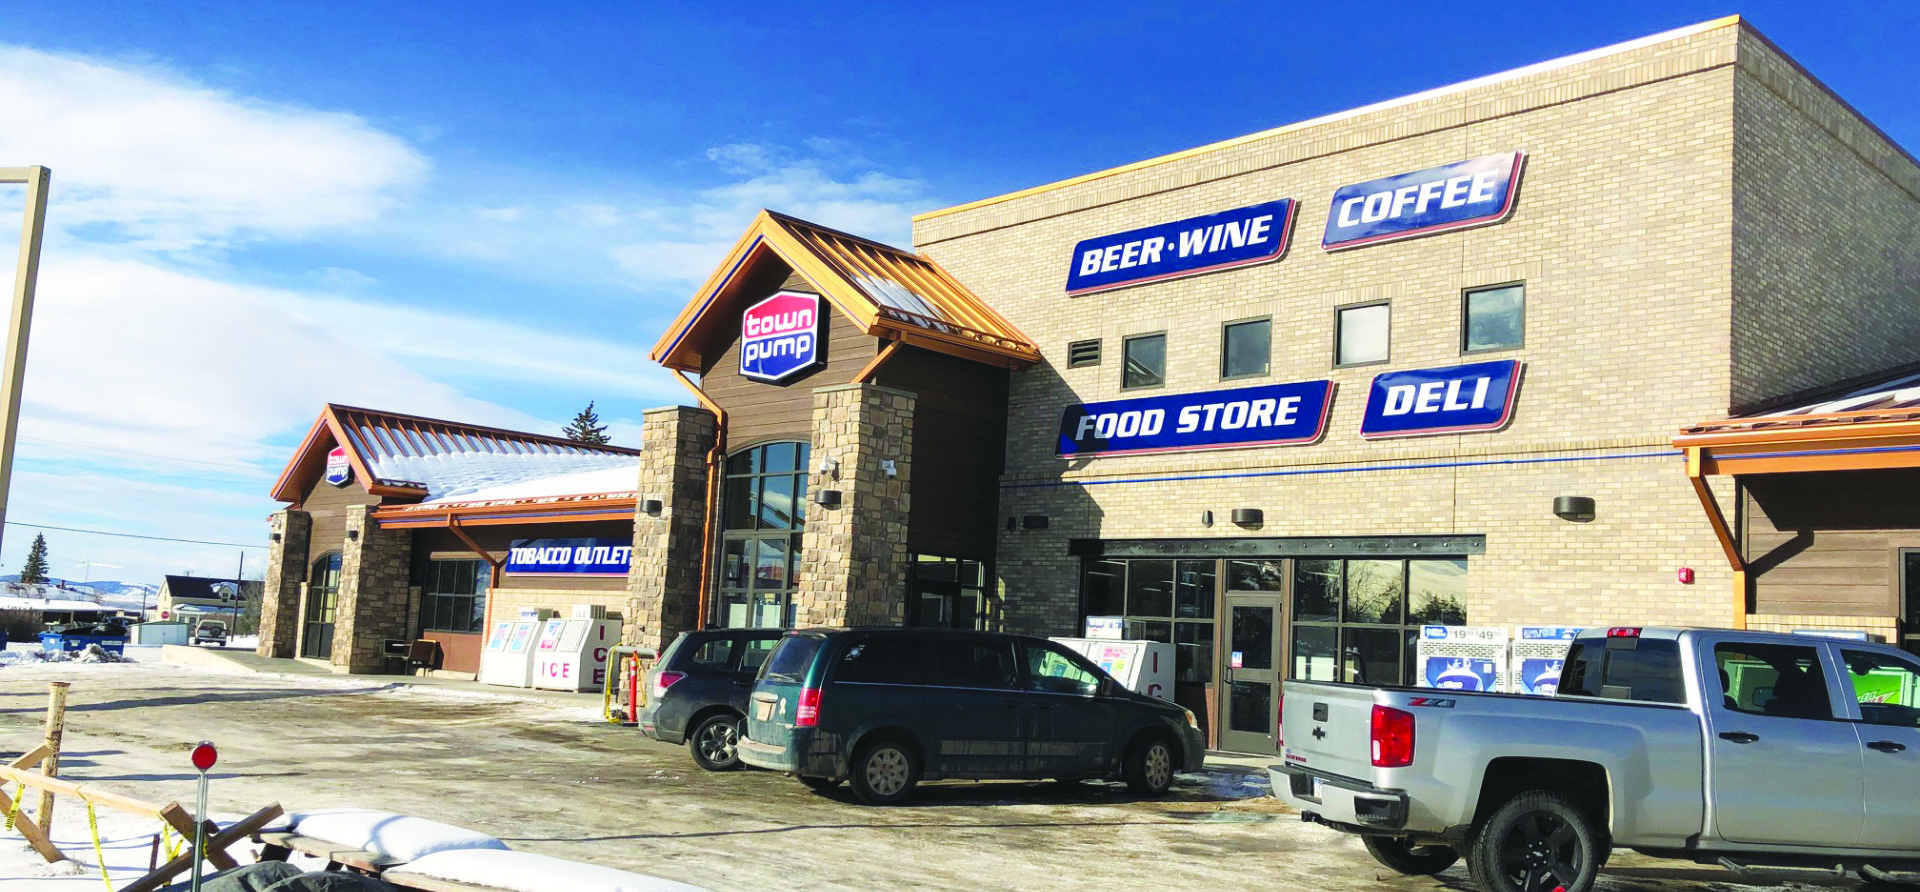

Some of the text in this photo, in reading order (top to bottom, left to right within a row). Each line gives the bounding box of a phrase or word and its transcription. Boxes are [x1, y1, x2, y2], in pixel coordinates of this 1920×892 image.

[1337, 169, 1499, 229] COFFEE
[746, 309, 812, 336] town
[745, 334, 811, 367] pump
[1382, 377, 1491, 416] DELI
[1075, 395, 1302, 441] FOOD STORE
[510, 546, 632, 565] TOBACCO OUTLET
[542, 661, 571, 678] ICE
[1408, 696, 1456, 708] Z71
